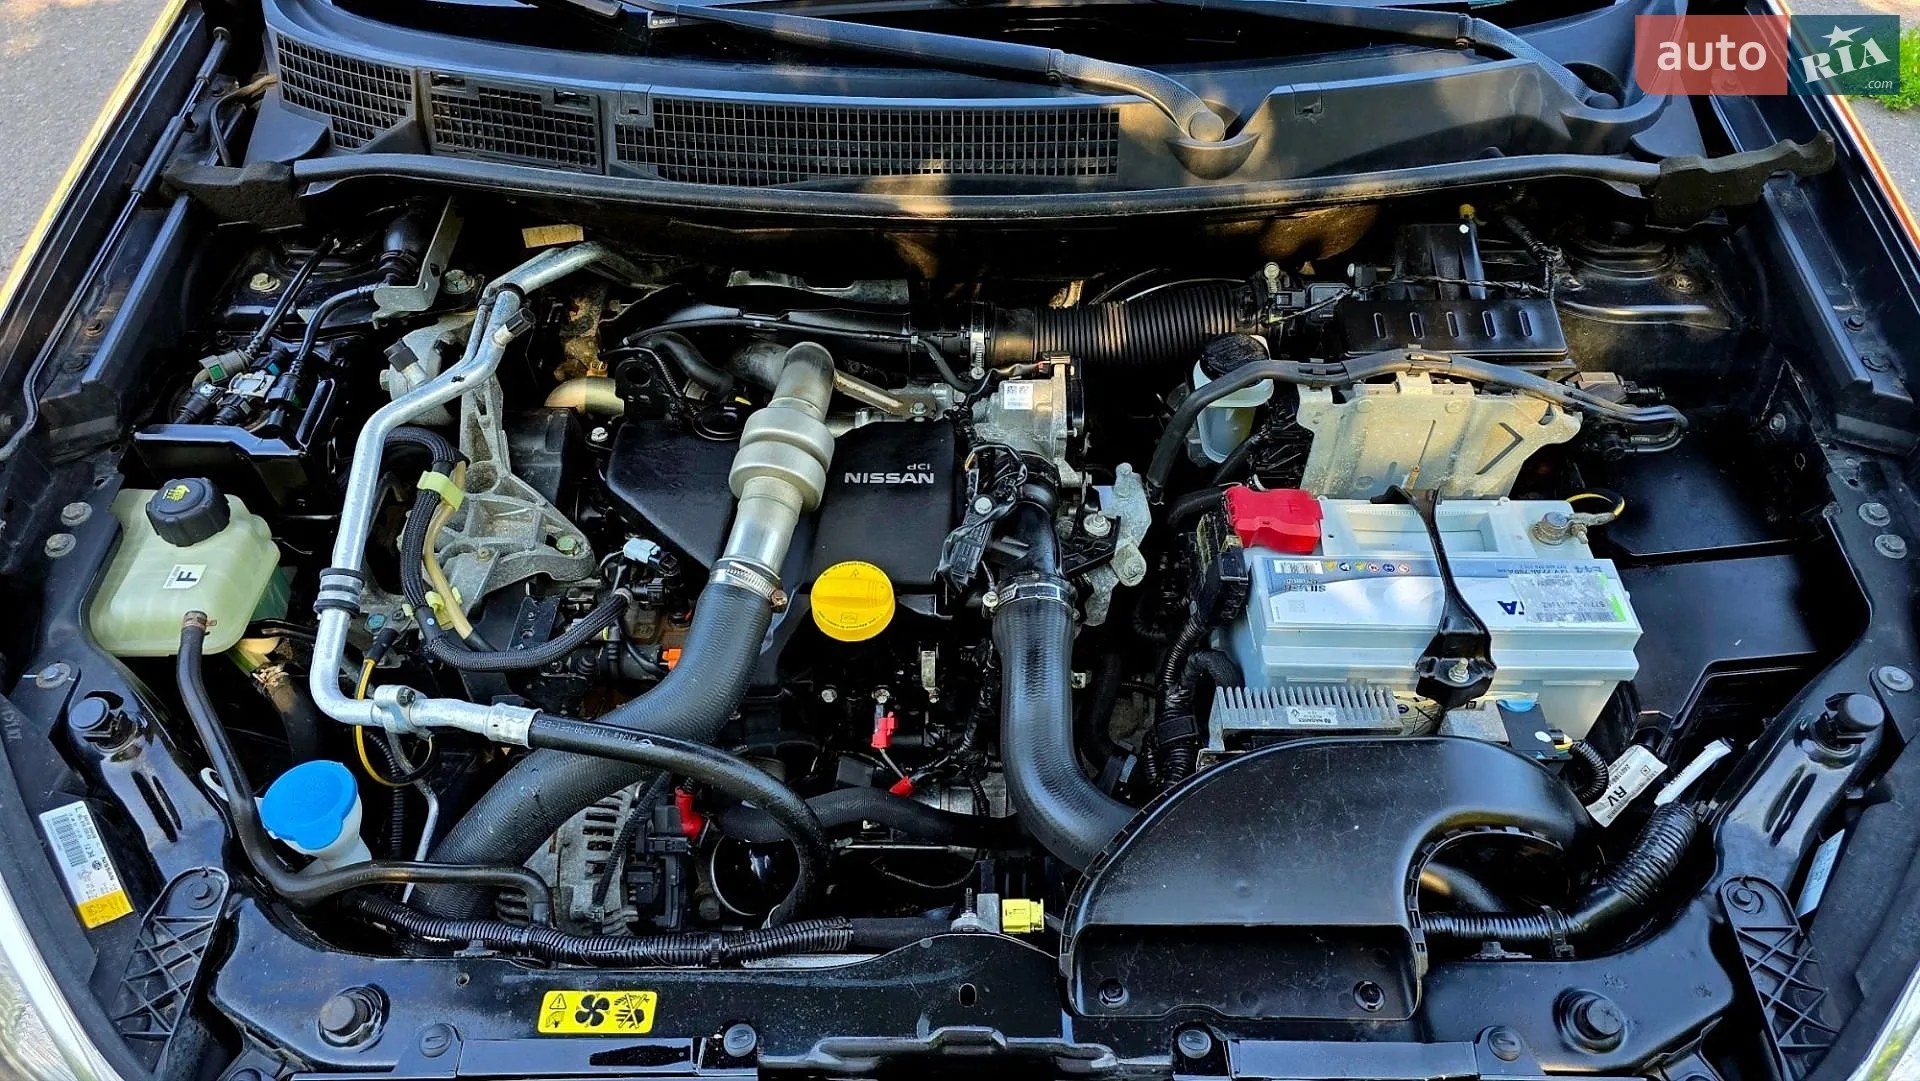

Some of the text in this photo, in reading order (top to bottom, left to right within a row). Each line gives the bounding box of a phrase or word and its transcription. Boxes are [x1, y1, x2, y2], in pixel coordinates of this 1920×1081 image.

[844, 472, 935, 484] NISSAN
[175, 570, 198, 582] F
[1607, 786, 1627, 807] RV
